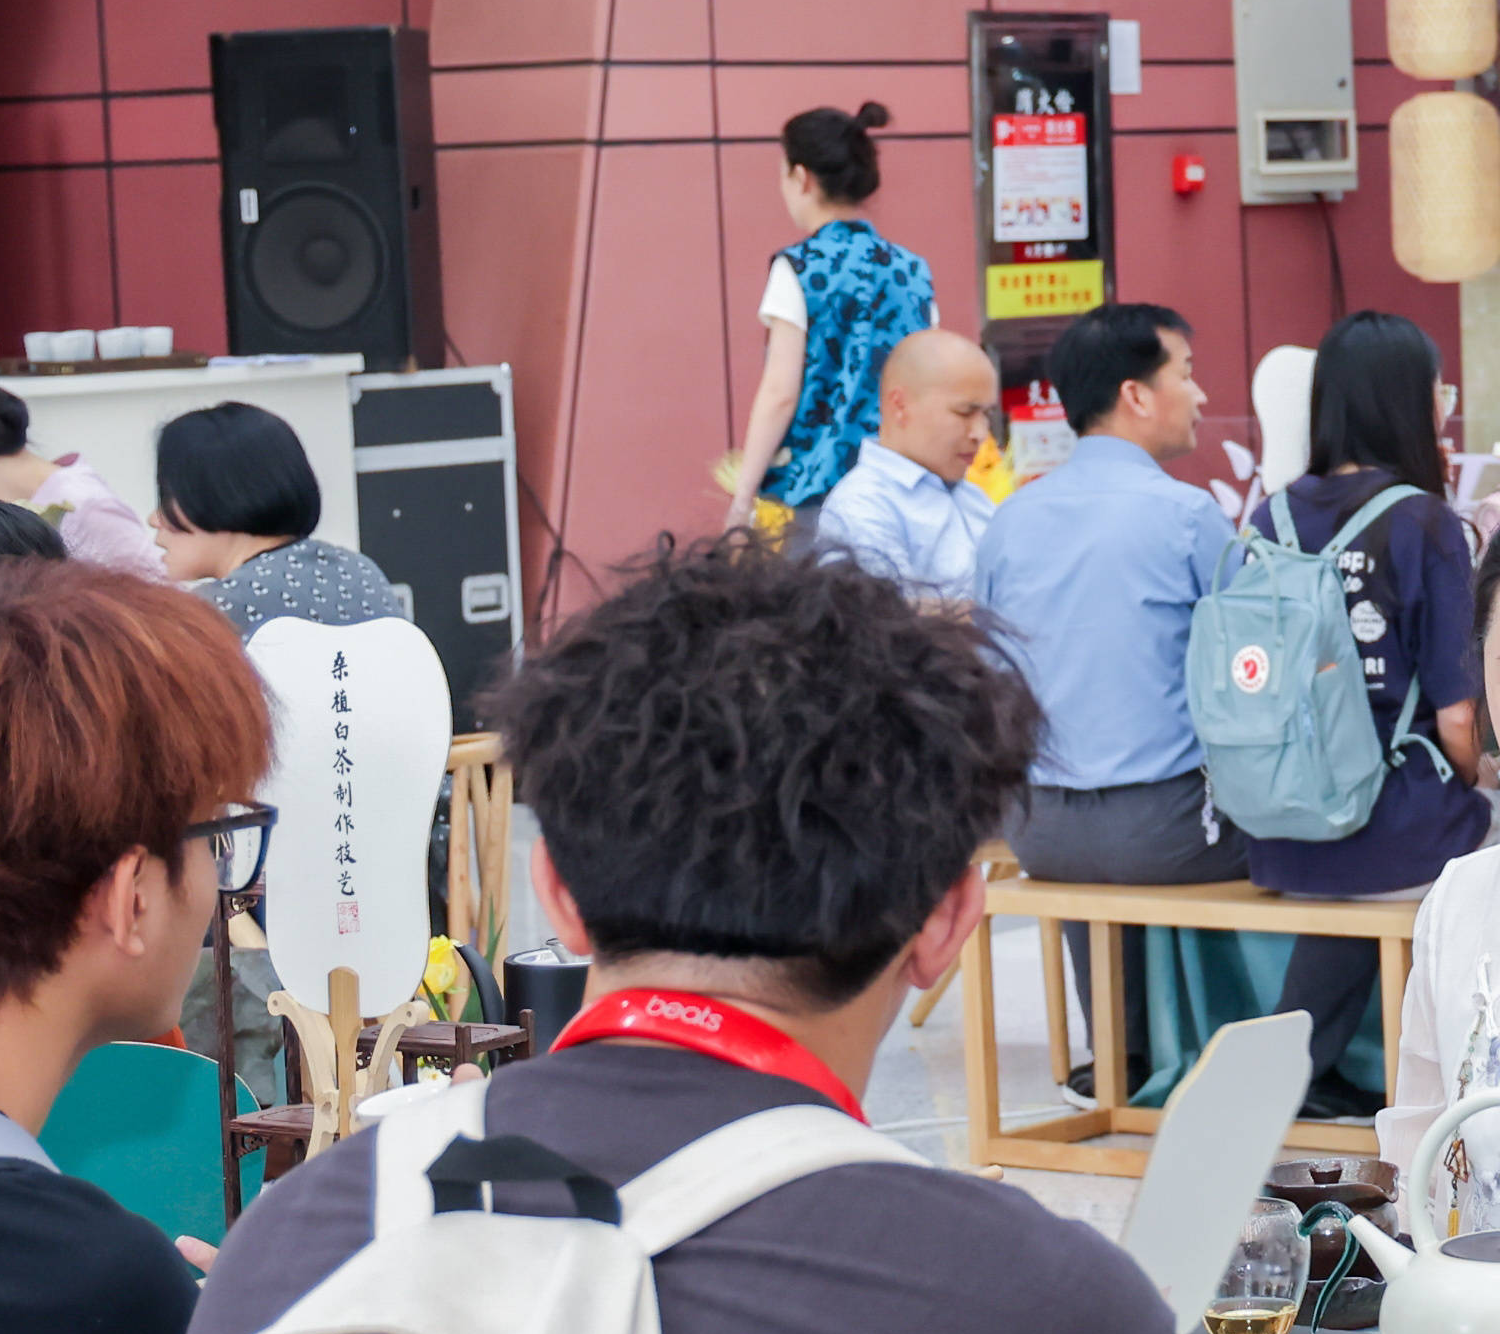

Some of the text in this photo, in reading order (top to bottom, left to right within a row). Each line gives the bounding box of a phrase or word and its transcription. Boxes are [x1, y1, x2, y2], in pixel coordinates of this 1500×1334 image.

[330, 650, 357, 896] 桑植白茶制作技艺
